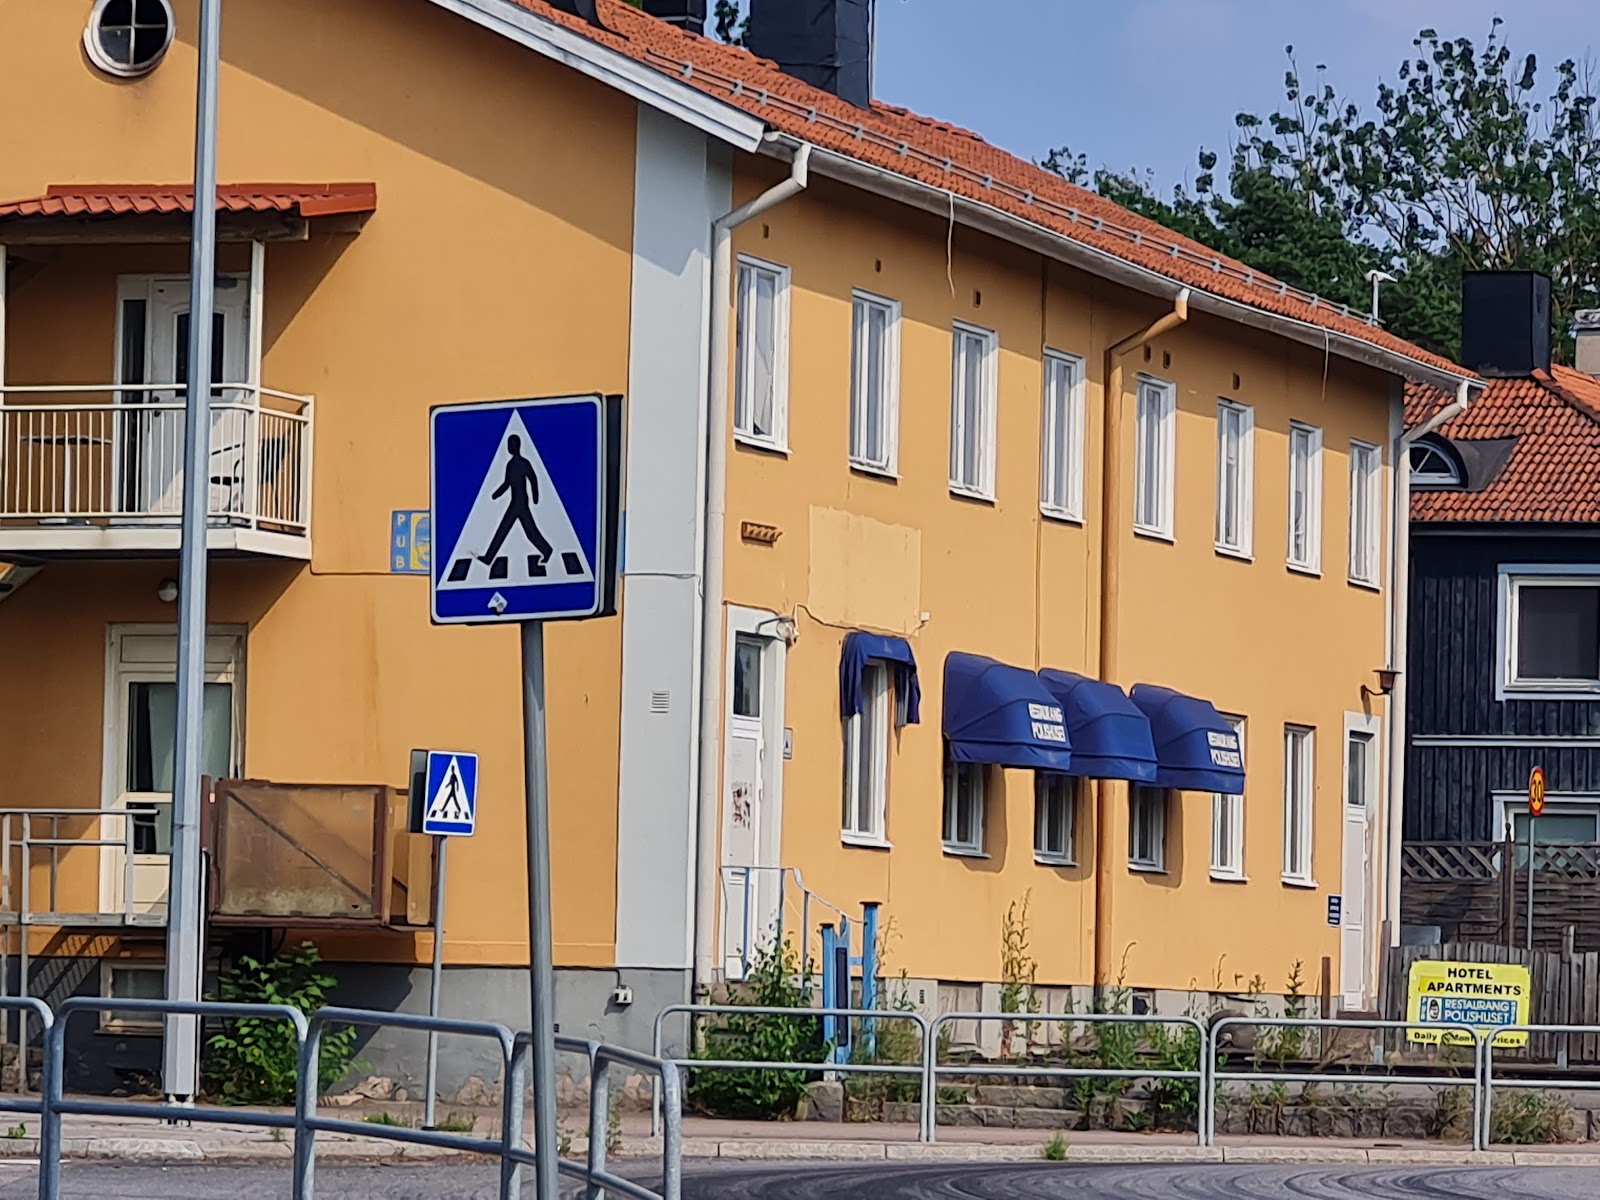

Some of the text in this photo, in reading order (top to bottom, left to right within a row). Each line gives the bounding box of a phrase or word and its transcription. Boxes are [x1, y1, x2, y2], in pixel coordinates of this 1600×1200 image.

[396, 513, 405, 568] PUB
[1448, 968, 1493, 980] HOTEL
[1427, 982, 1521, 995] APARTMENTS
[1444, 1000, 1510, 1012] RESTAURANG
[1414, 1032, 1437, 1042] Daily
